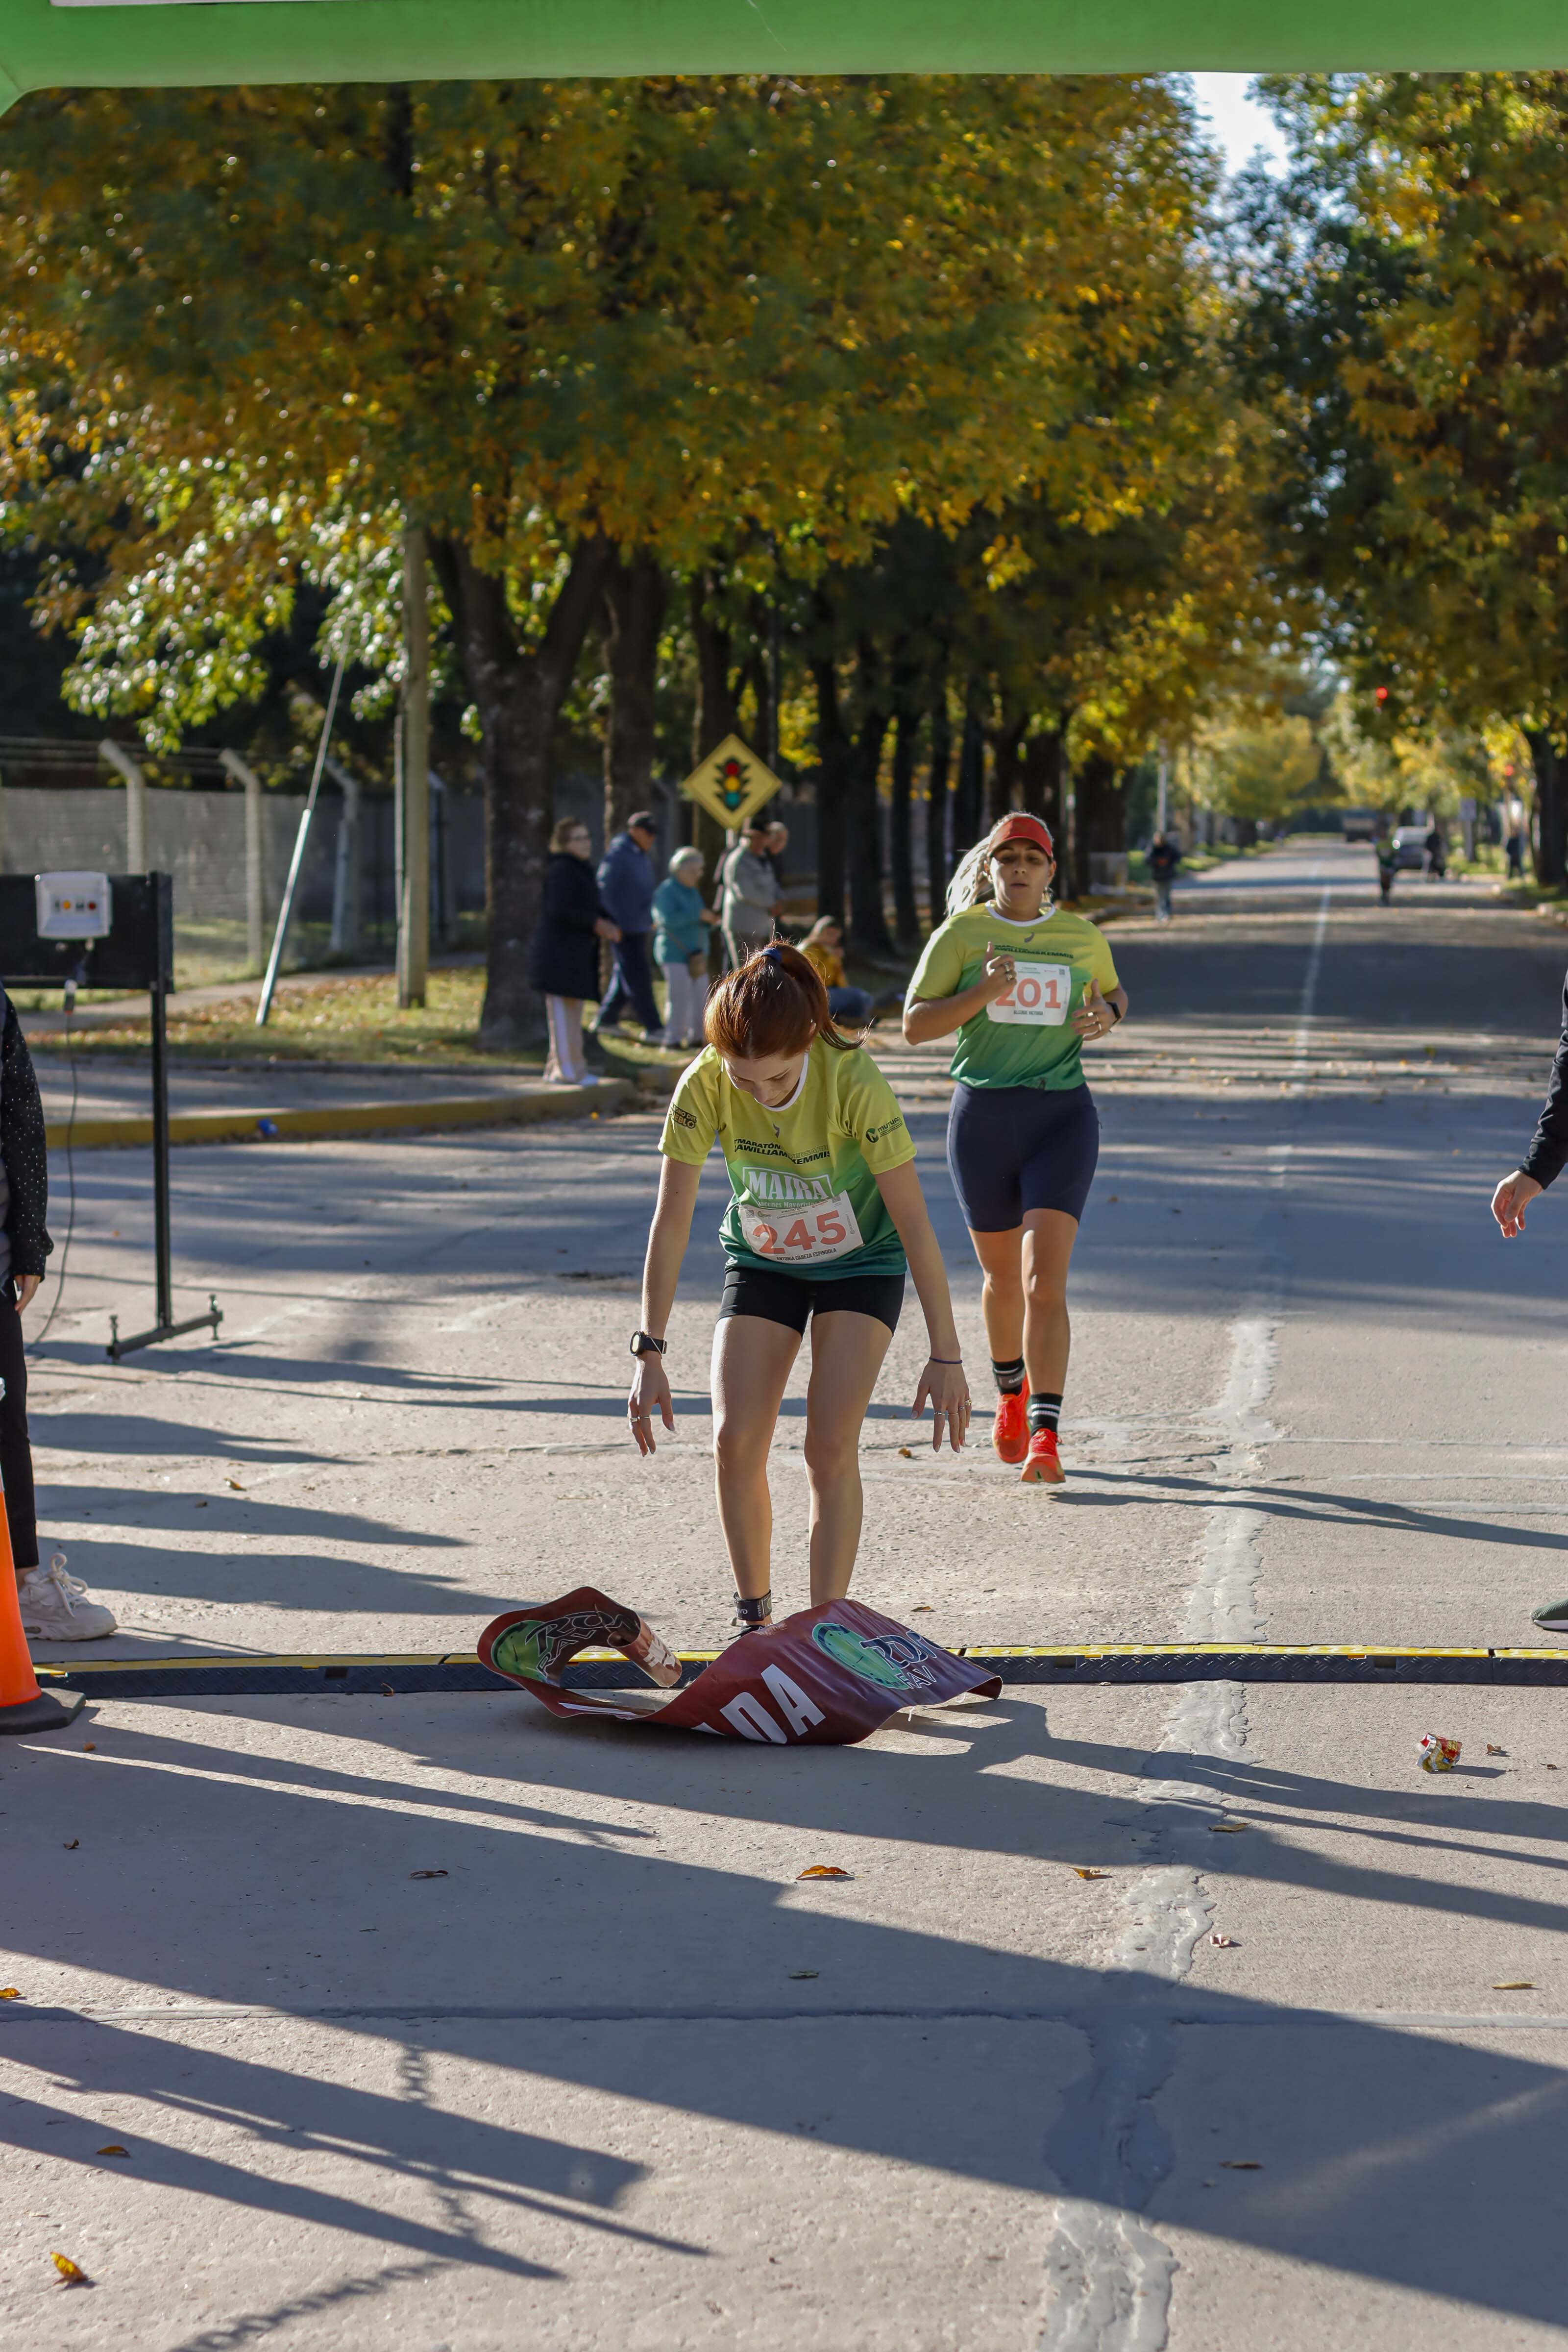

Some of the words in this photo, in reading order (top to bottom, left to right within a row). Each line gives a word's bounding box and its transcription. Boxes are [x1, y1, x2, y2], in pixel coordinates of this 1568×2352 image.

[748, 1171, 829, 1200] MAIRA
[753, 1210, 846, 1254] 245
[812, 1248, 837, 1257] ESPINDOLA
